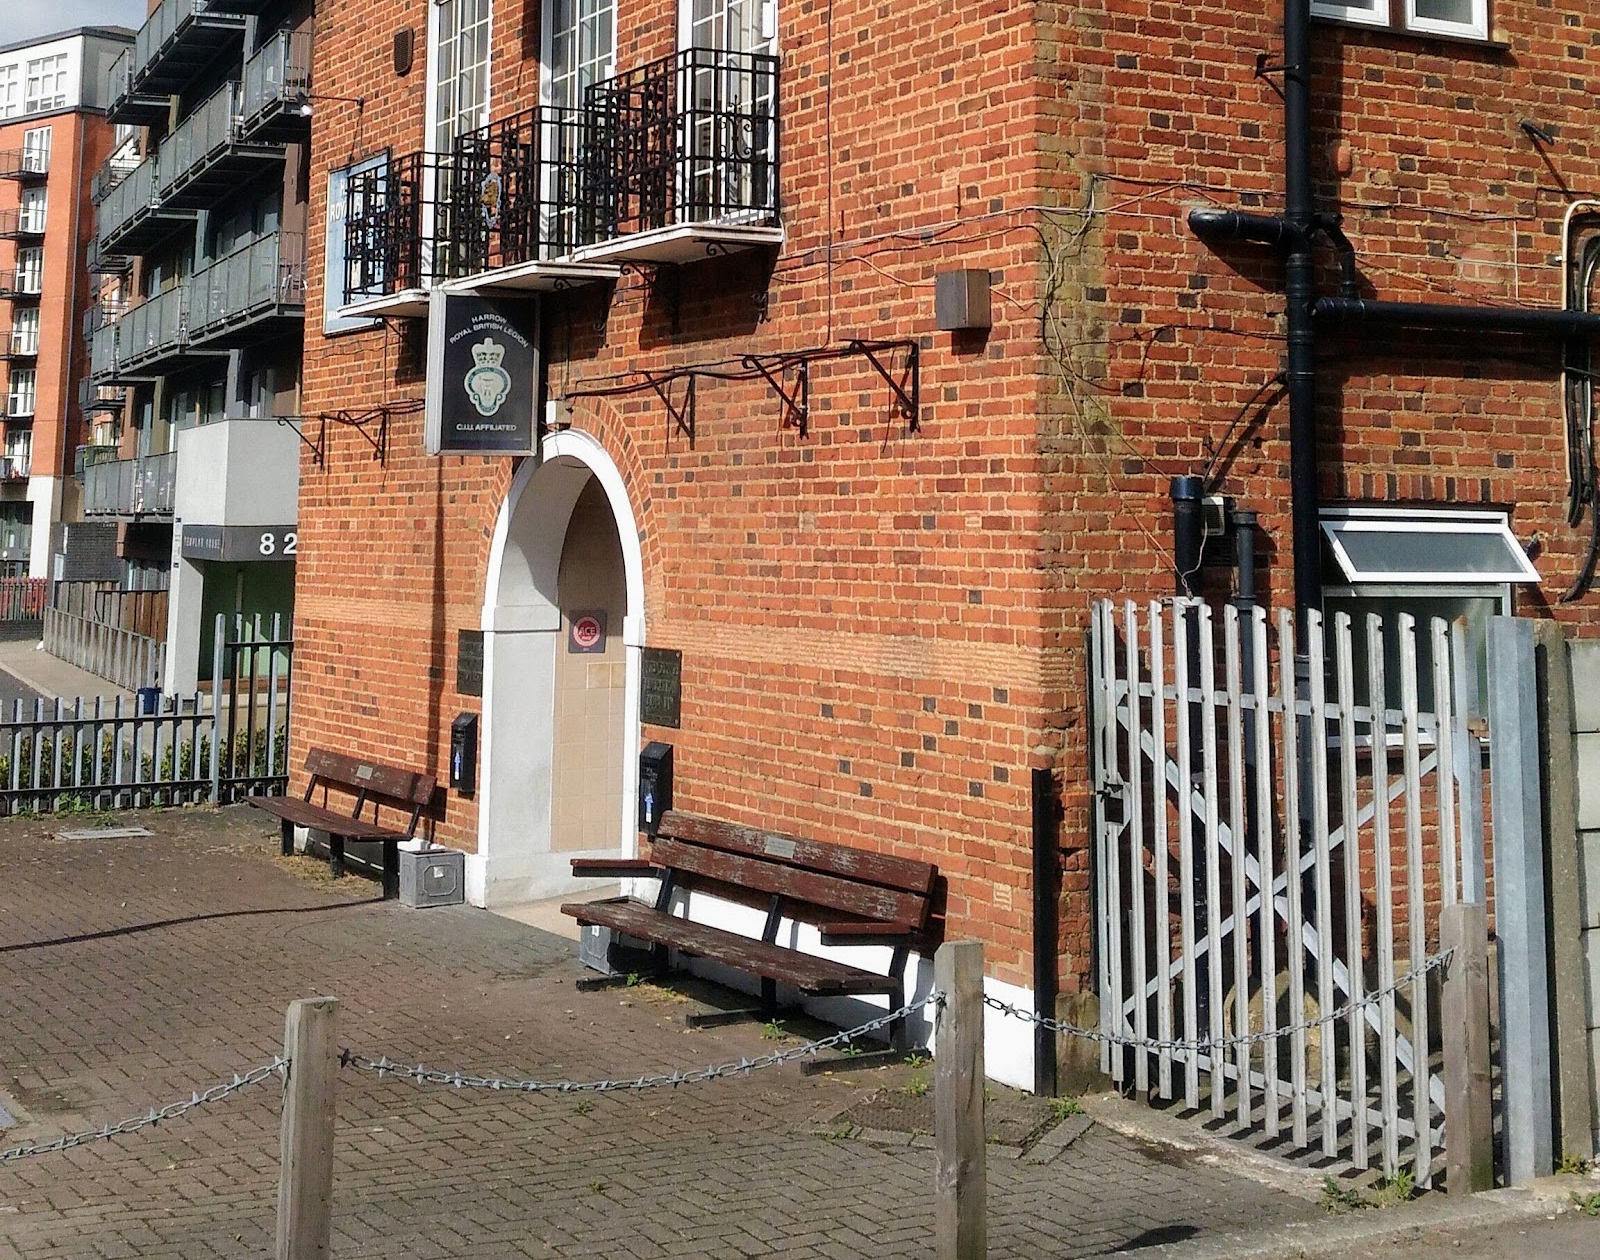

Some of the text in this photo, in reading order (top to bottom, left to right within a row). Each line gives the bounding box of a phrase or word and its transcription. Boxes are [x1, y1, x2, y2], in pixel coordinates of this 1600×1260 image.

[471, 313, 507, 324] HARROW
[449, 322, 529, 348] ROYAL BRITISH LEGION
[579, 627, 596, 636] ACE
